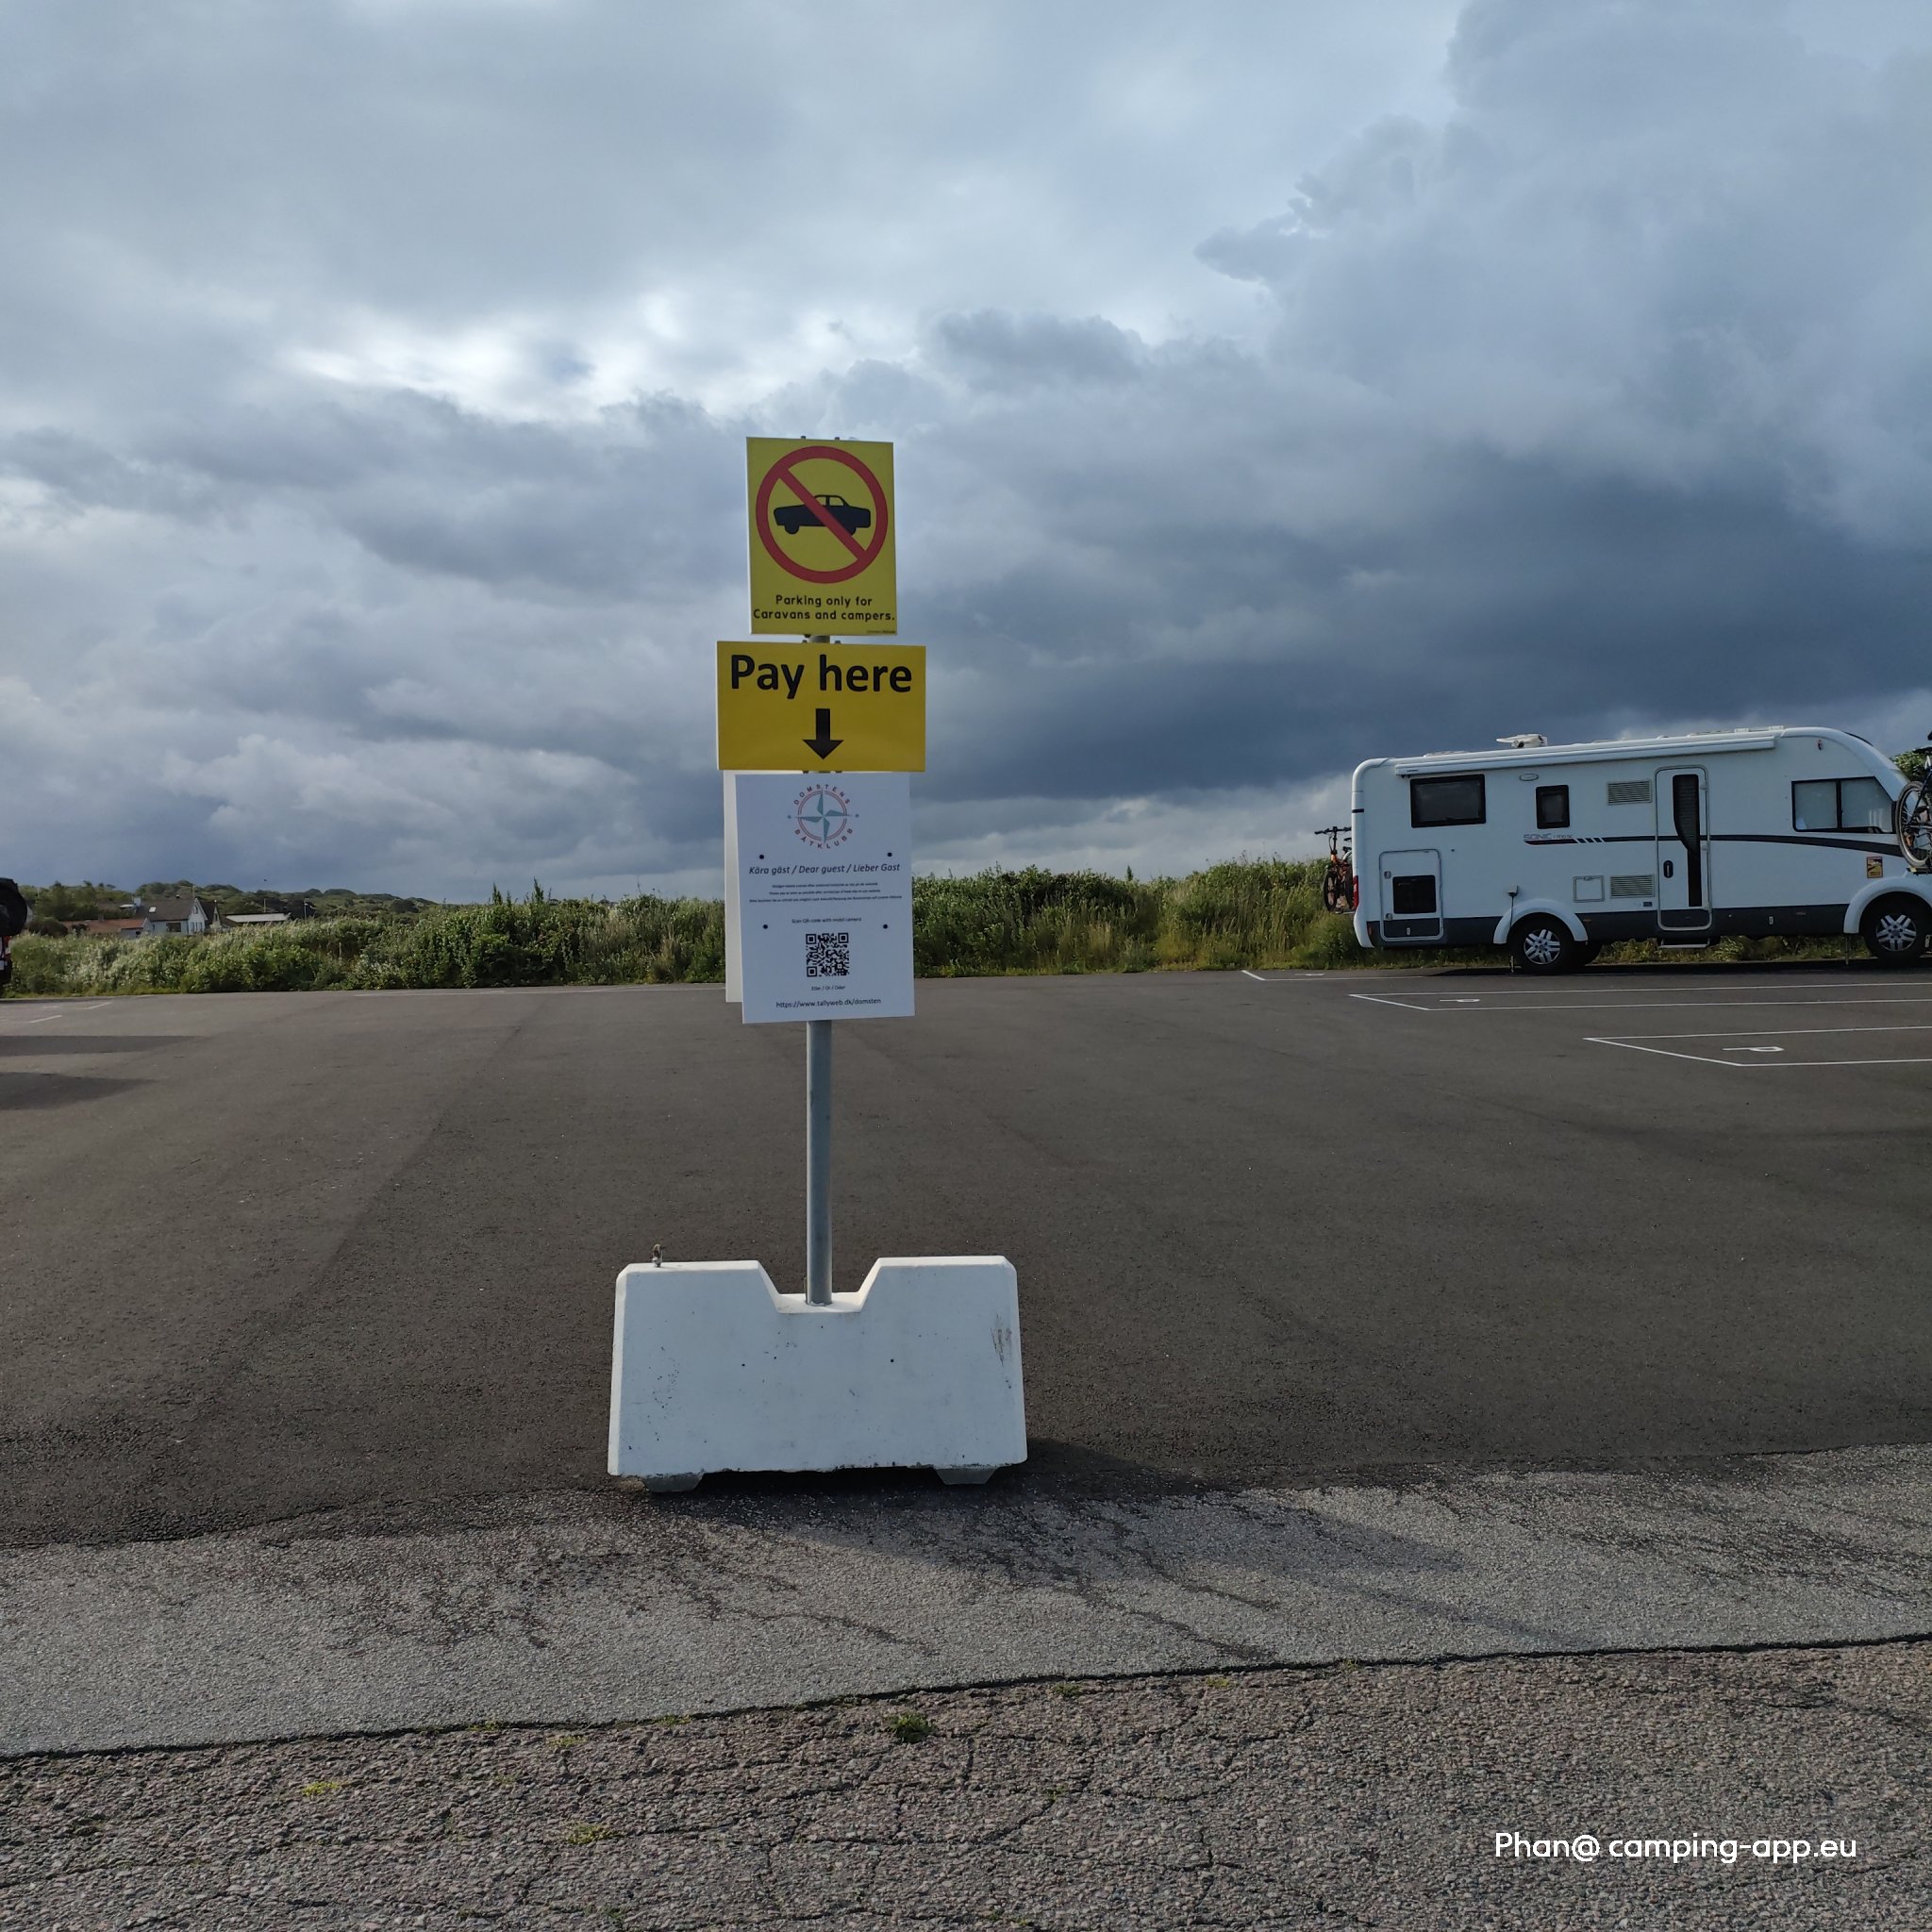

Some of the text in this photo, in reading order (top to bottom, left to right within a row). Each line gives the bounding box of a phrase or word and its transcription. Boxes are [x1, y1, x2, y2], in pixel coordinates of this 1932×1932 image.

[775, 594, 873, 608] Parking only for
[753, 608, 895, 623] Caravans and campers.
[731, 654, 912, 699] Pay here
[749, 866, 769, 874] Kära
[799, 865, 820, 874] Dear
[821, 865, 845, 874] guest
[853, 863, 879, 873] Lieber
[881, 863, 900, 872] Gast
